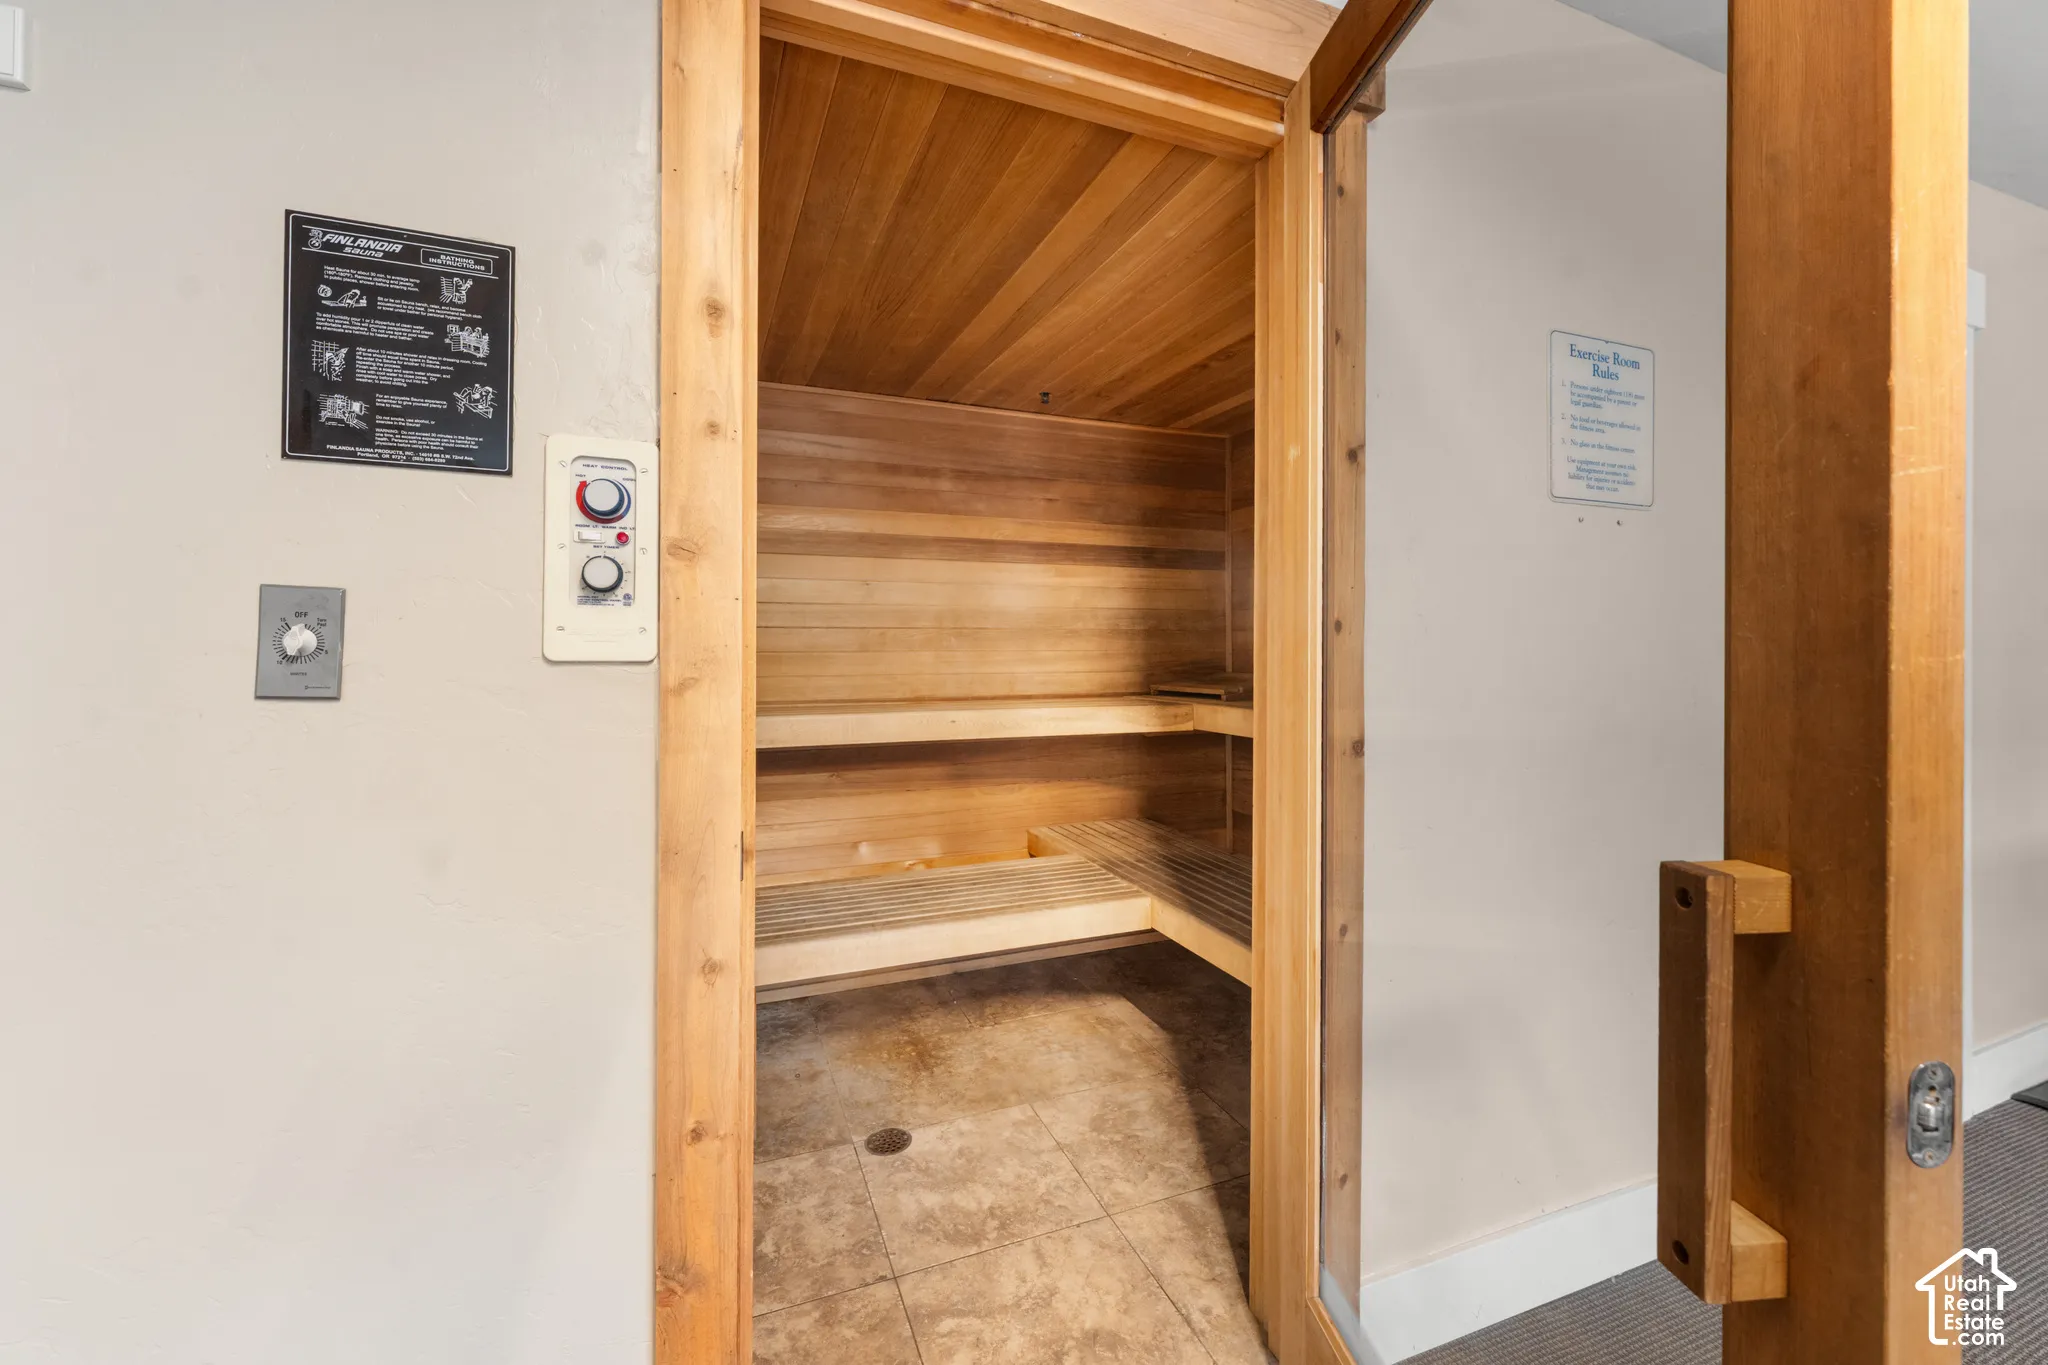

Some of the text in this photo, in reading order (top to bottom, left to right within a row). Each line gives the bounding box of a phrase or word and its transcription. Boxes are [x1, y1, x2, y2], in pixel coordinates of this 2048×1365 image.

[322, 233, 403, 253] FINLANDIA
[342, 246, 383, 258] sauna
[440, 254, 474, 264] BATHING
[429, 257, 485, 271] INSTRUCTIONS
[1570, 343, 1640, 370] Exercise Room
[1592, 363, 1619, 380] Rules
